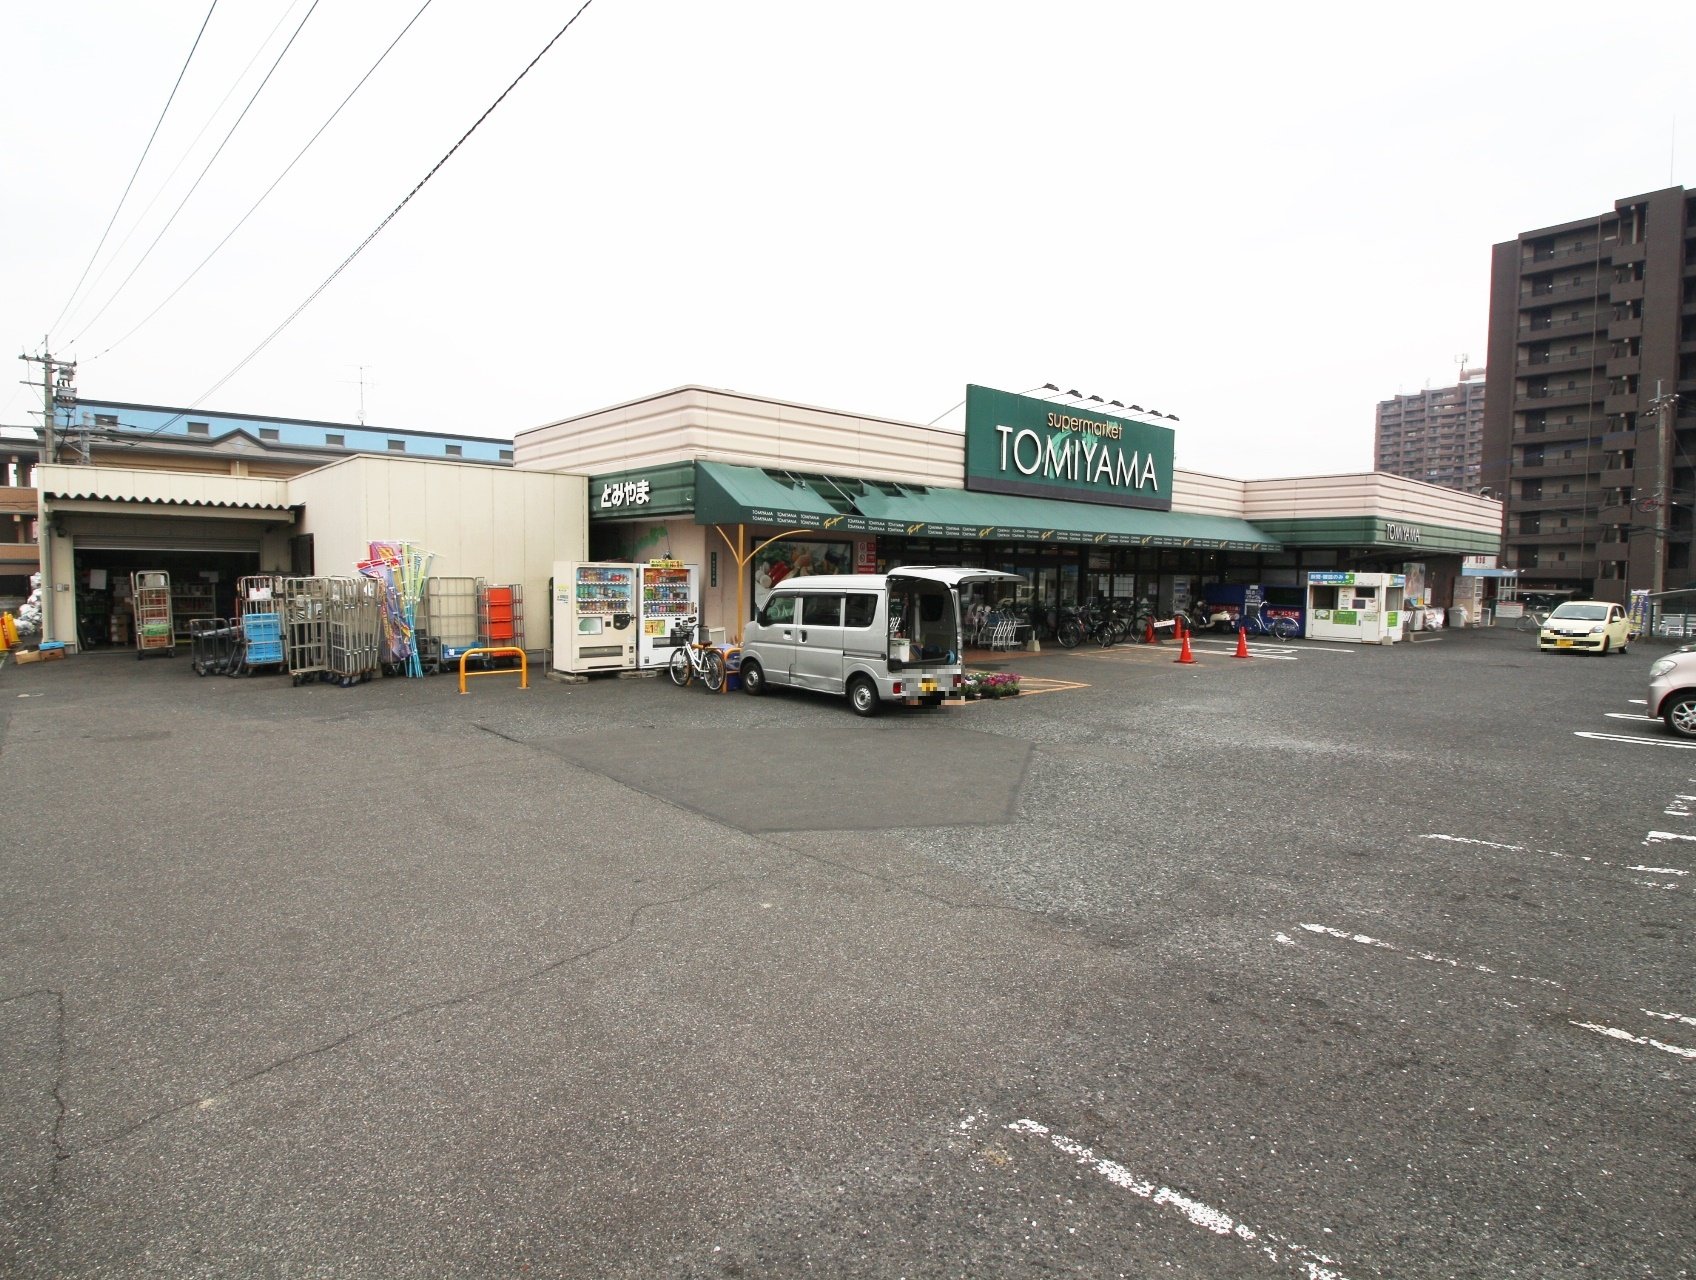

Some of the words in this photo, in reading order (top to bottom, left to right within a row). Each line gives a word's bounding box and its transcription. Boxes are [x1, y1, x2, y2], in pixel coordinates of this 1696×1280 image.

[1047, 412, 1123, 440] supermarket
[996, 425, 1158, 491] TOMIYAMA
[600, 479, 651, 508] とみやま
